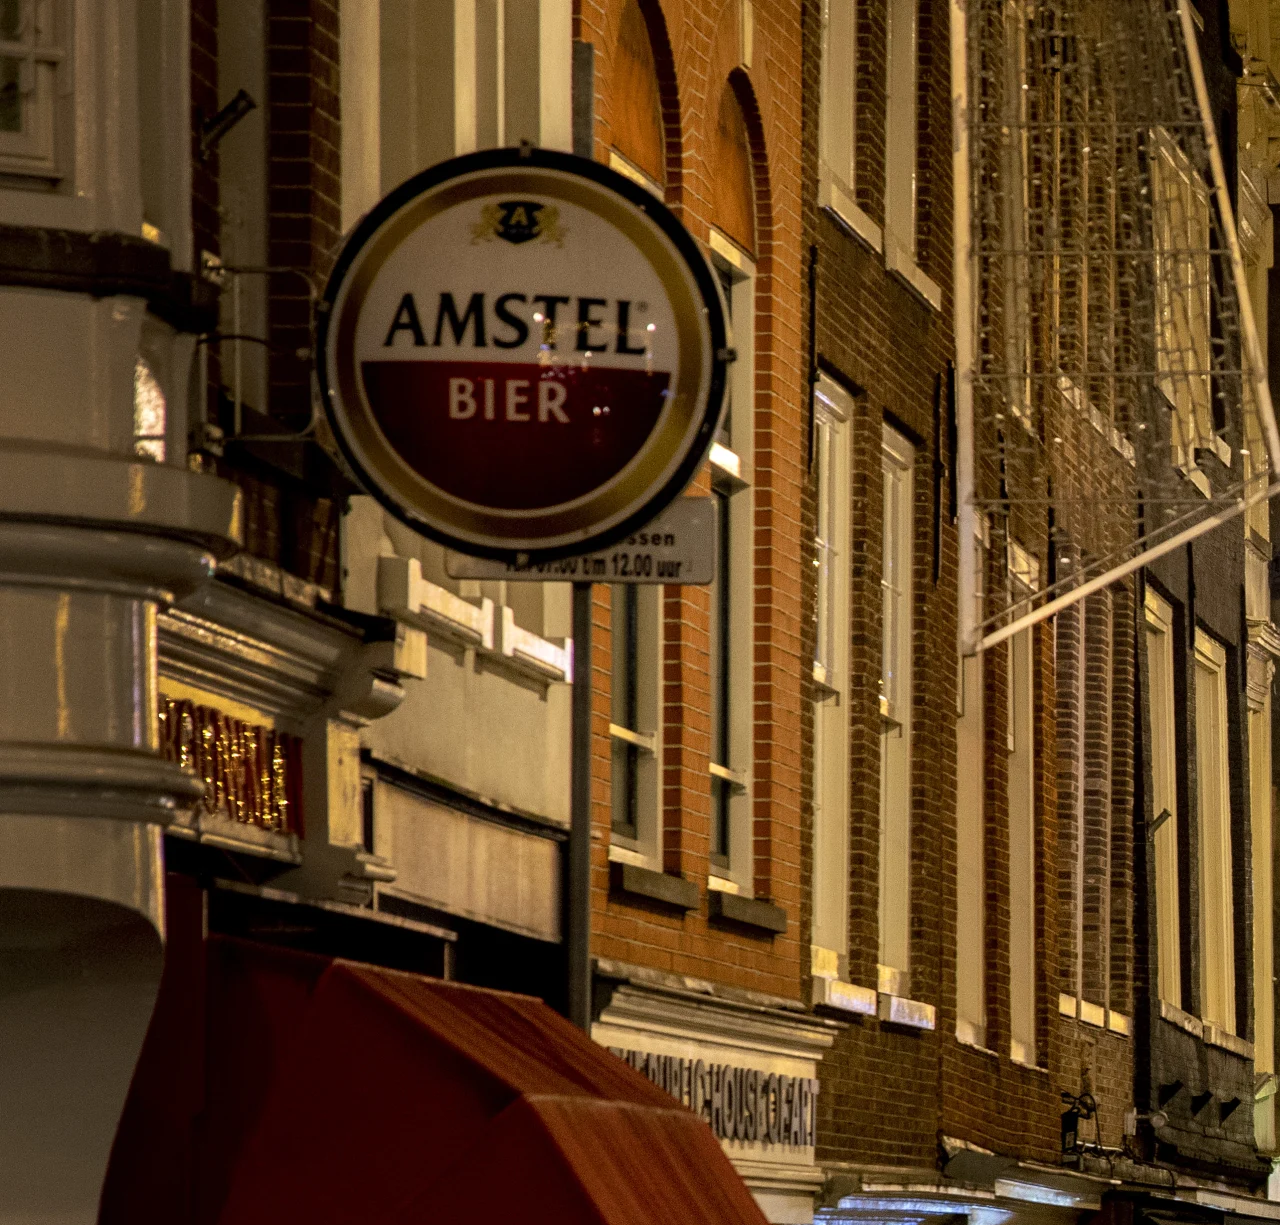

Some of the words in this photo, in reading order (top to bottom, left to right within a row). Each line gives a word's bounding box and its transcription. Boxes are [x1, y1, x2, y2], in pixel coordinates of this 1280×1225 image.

[383, 293, 647, 355] AMSTEL
[449, 377, 570, 423] BIER
[613, 553, 652, 577] 12.00
[657, 560, 682, 577] uur
[711, 1063, 767, 1142] HOUSE
[791, 1077, 819, 1146] ART
